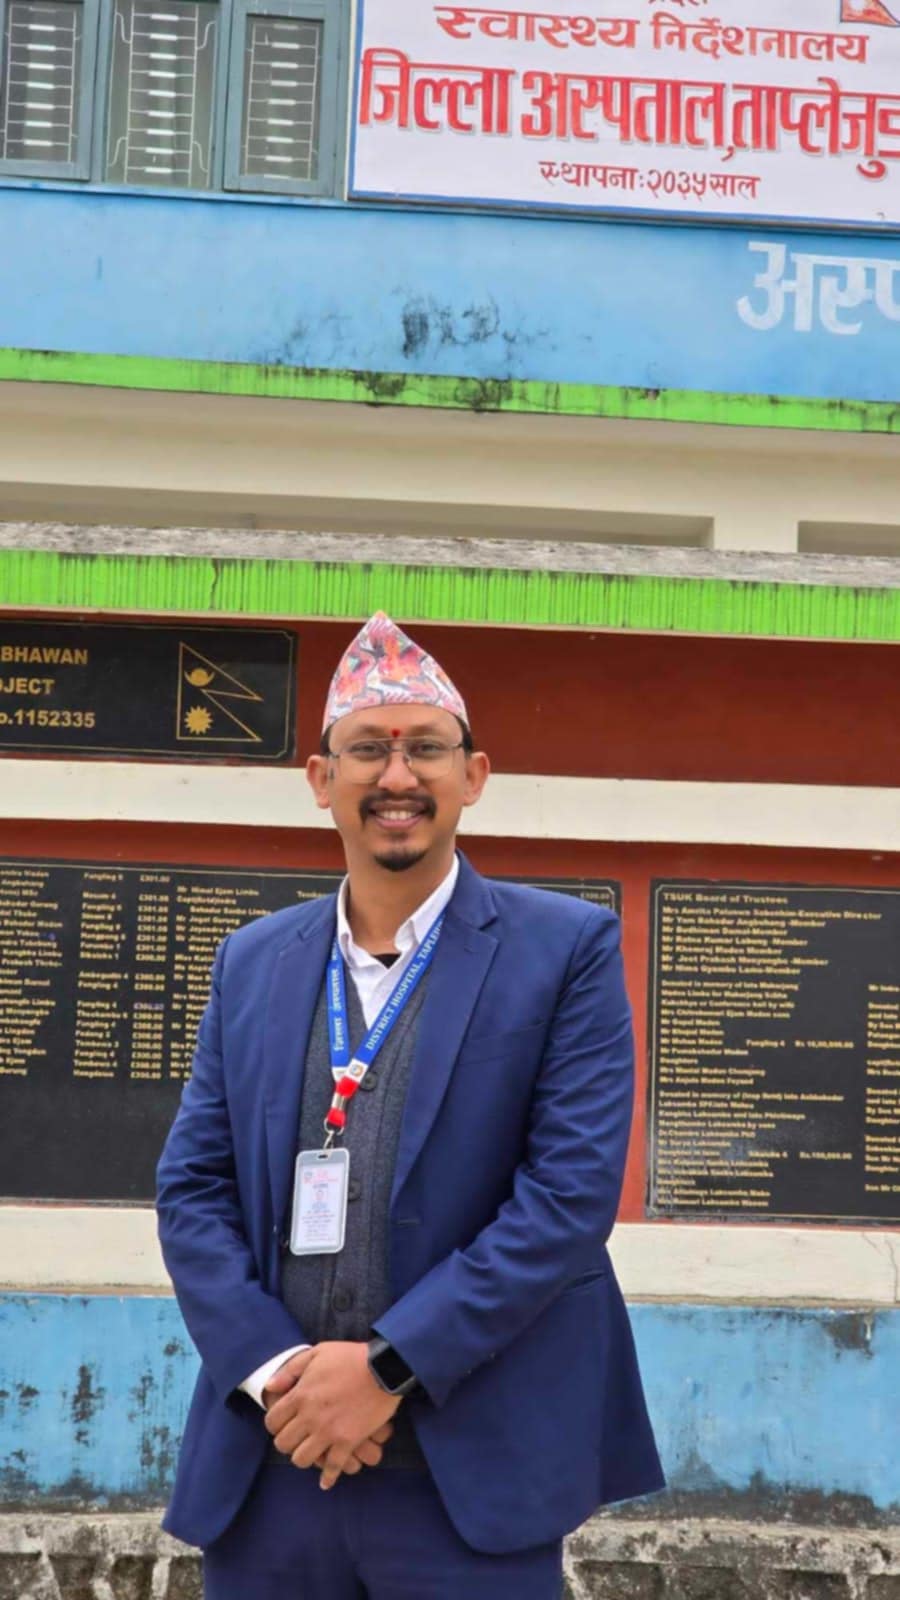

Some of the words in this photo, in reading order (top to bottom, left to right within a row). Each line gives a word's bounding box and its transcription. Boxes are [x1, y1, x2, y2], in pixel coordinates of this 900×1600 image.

[651, 12, 869, 63] निर्देशनालय
[360, 48, 515, 135] जिल्ला
[1, 646, 88, 665] BHAWAN
[696, 894, 727, 902] Board
[729, 895, 741, 903] of
[743, 896, 788, 904] Trustees
[366, 1006, 396, 1050] DISTRICT
